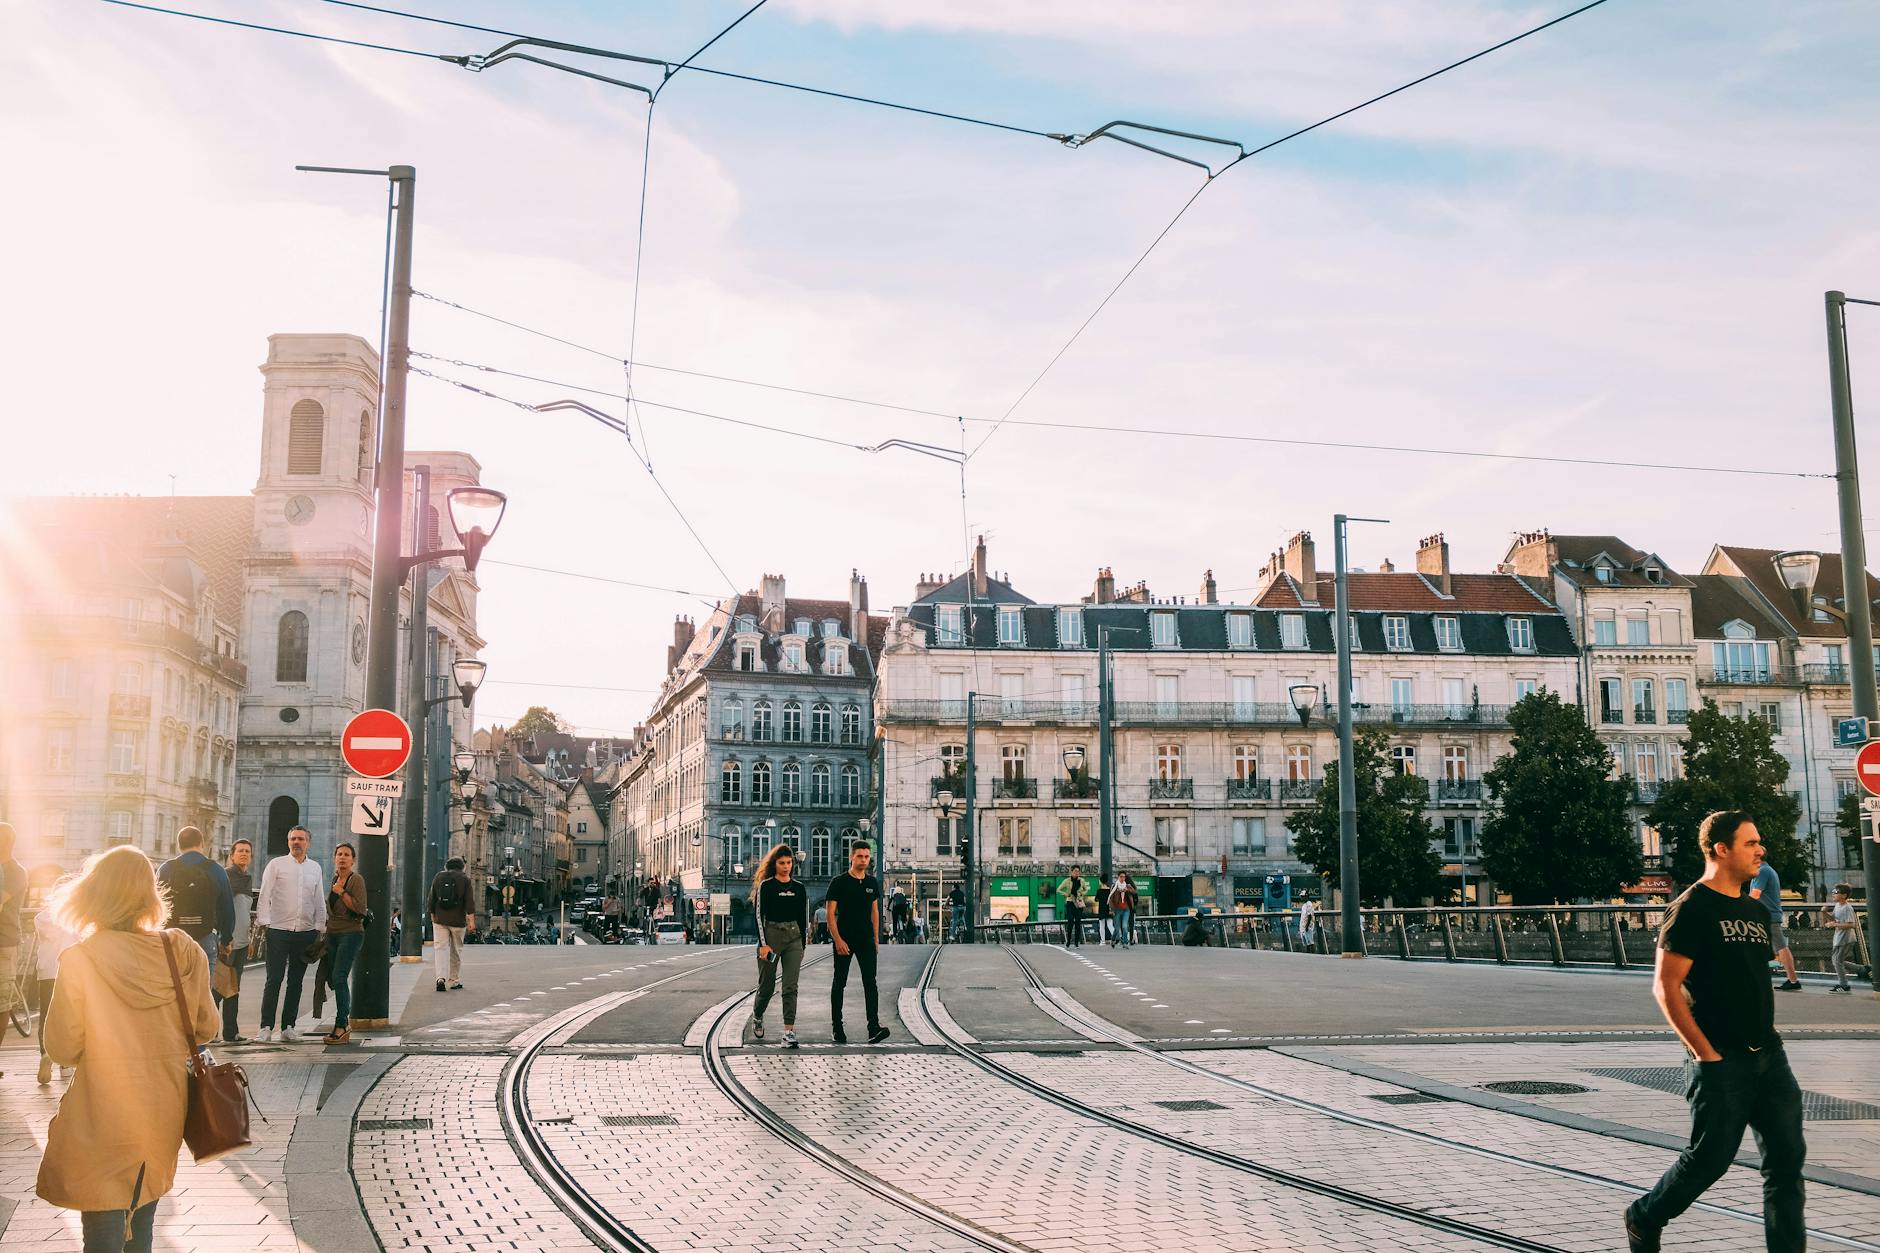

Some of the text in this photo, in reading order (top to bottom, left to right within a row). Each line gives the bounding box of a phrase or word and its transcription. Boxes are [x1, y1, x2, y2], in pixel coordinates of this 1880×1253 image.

[350, 782, 398, 792] SAUF TRAM
[996, 864, 1100, 874] PHARMACIE DES UAIS
[1235, 887, 1263, 896] PRESSE
[1719, 919, 1768, 939] BOSS
